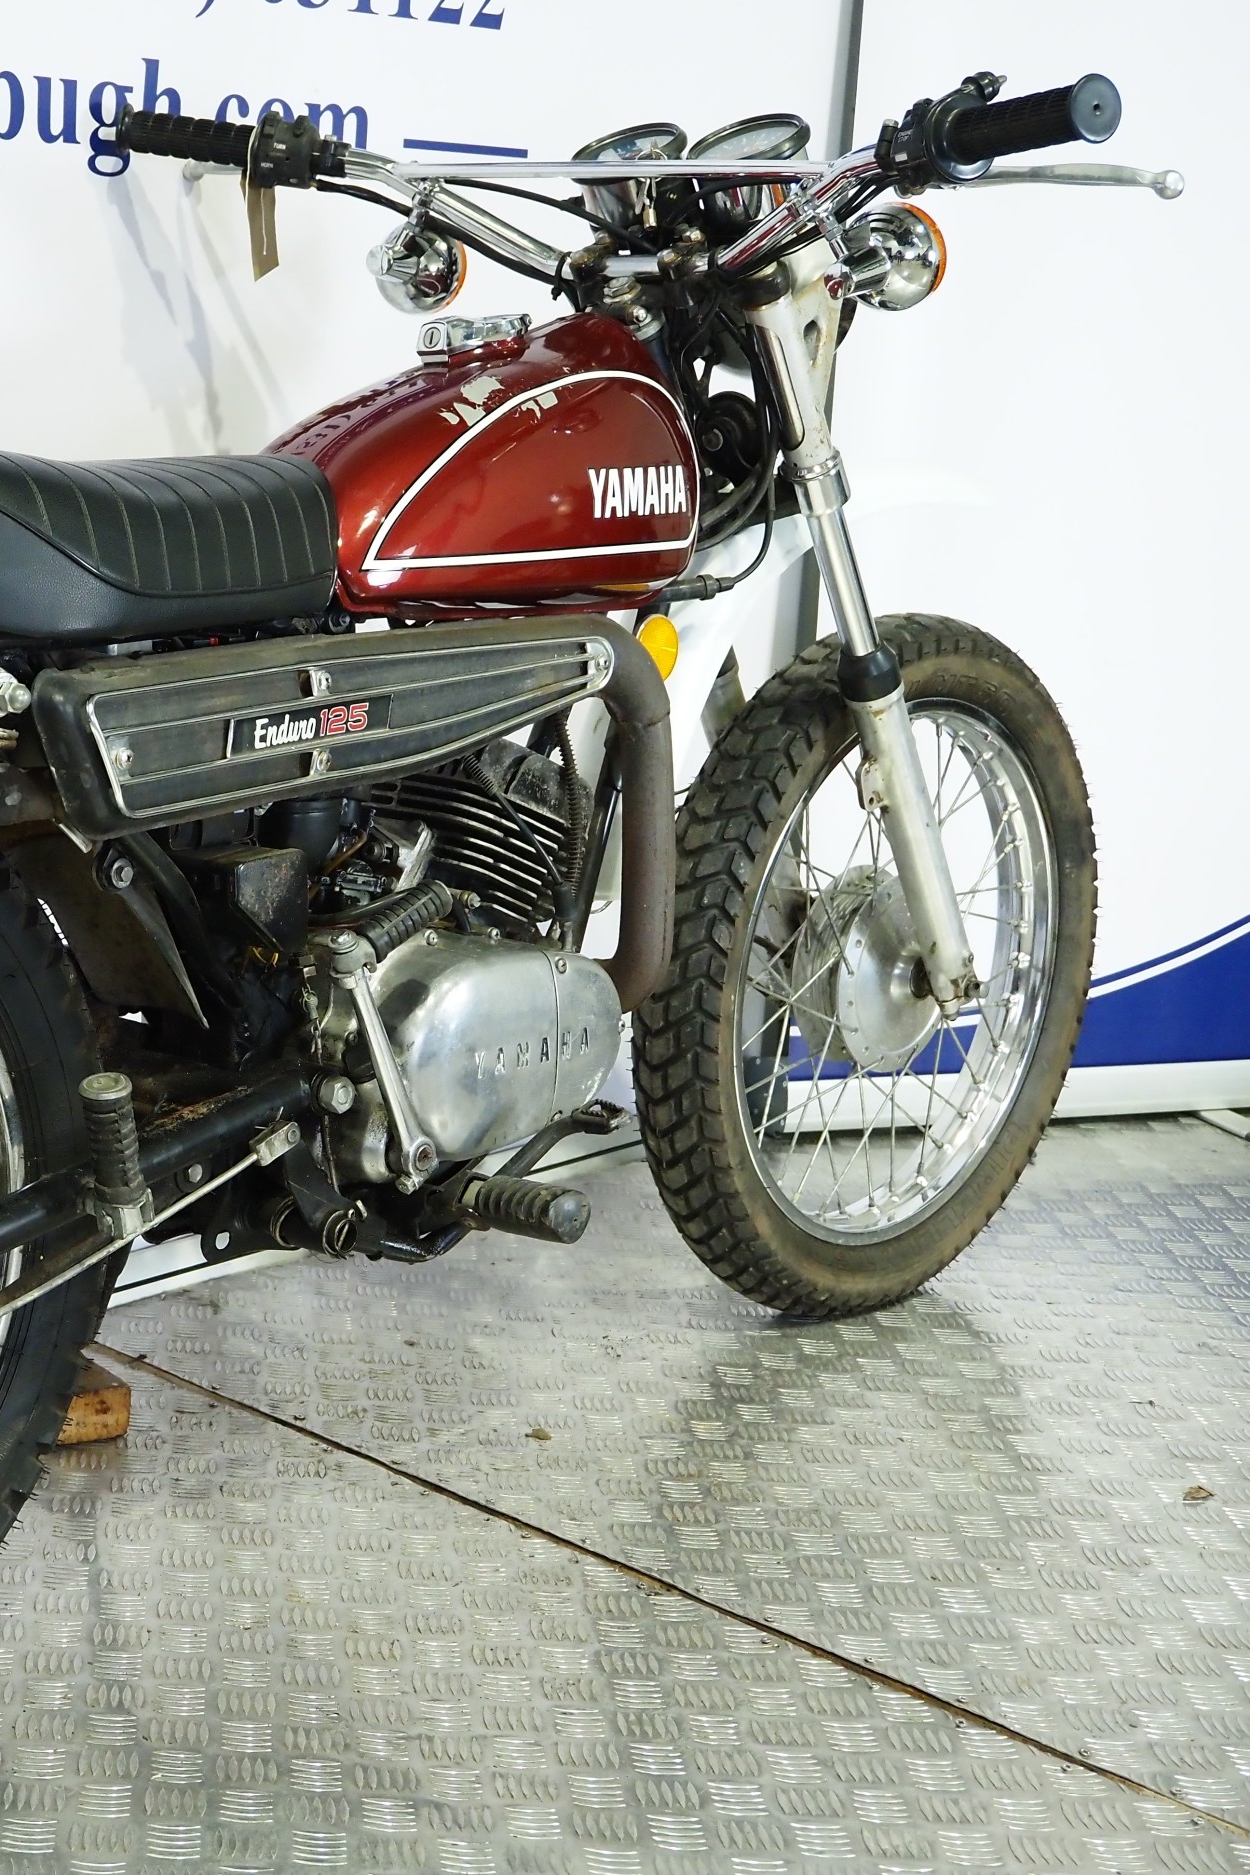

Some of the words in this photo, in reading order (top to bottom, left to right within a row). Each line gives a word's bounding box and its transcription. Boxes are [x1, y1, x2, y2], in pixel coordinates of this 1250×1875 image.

[273, 142, 286, 150] TURN
[587, 464, 688, 519] YAMAHA
[253, 713, 317, 750] Enduro
[318, 702, 370, 737] 125
[474, 1026, 590, 1080] YAMAHA
